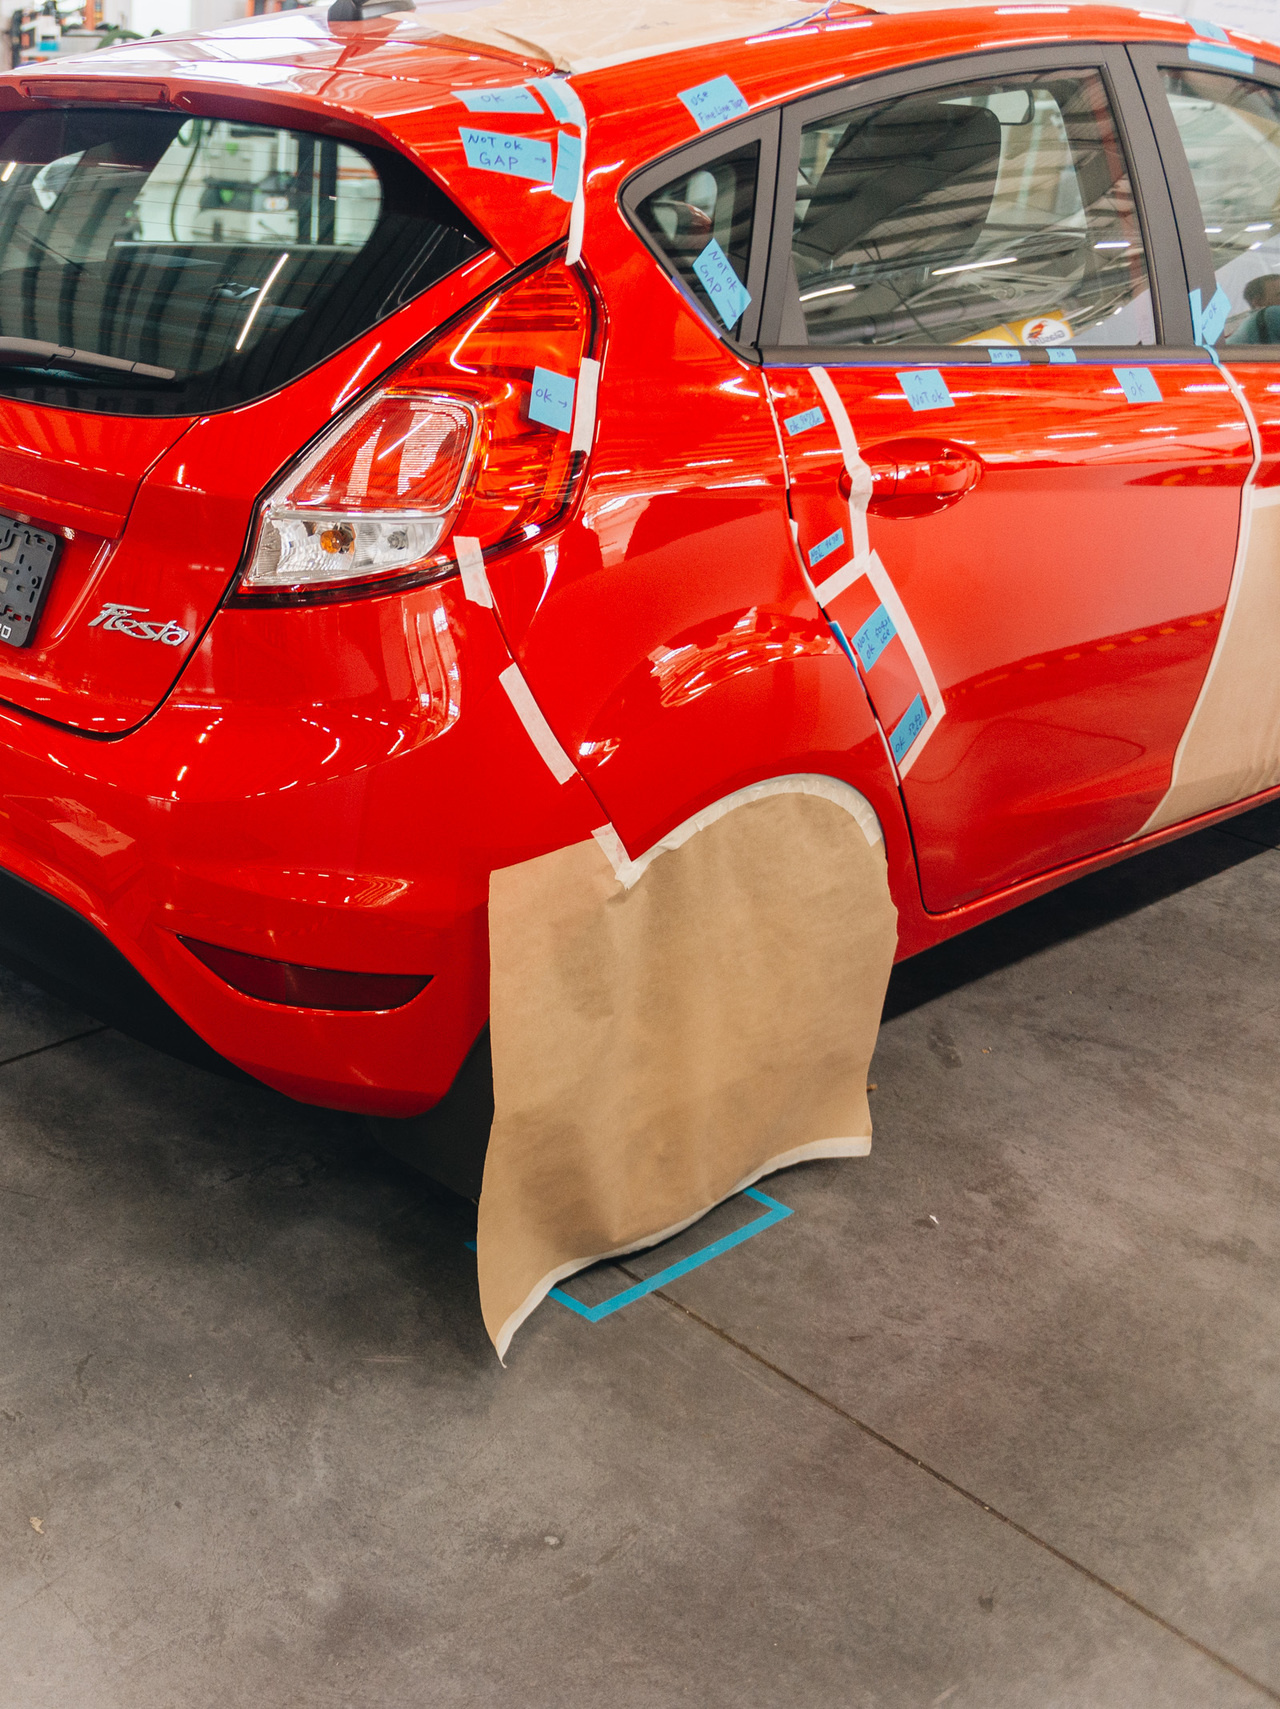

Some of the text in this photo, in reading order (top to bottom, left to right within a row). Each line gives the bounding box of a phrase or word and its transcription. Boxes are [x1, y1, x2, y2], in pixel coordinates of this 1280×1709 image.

[479, 151, 520, 171] GAP
[699, 263, 722, 295] GAP
[87, 603, 190, 646] Fiesta
